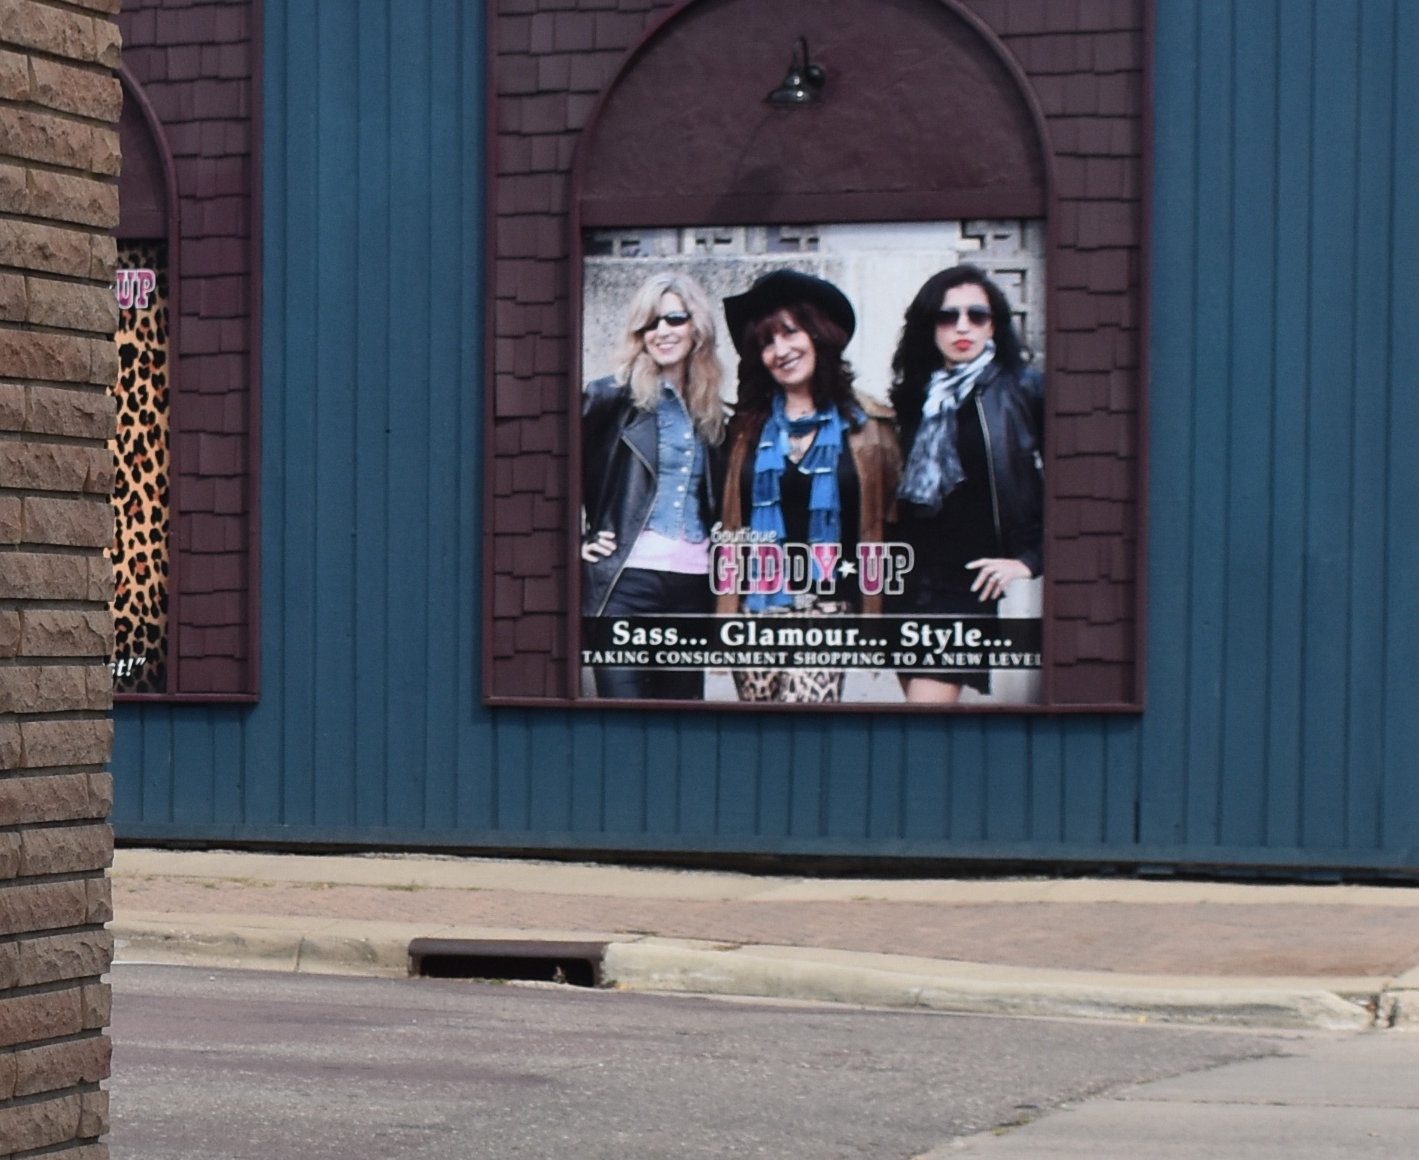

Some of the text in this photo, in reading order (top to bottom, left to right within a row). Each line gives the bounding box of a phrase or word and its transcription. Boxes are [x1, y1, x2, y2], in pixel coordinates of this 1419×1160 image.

[116, 268, 157, 310] UP
[710, 521, 779, 543] boutique
[709, 542, 915, 595] GIDDY UP
[612, 620, 1012, 654] Sass... Glamour... Style...
[581, 650, 1043, 666] TAKING CONSIGNMENT SHOPPING TO A NEW LEVEL
